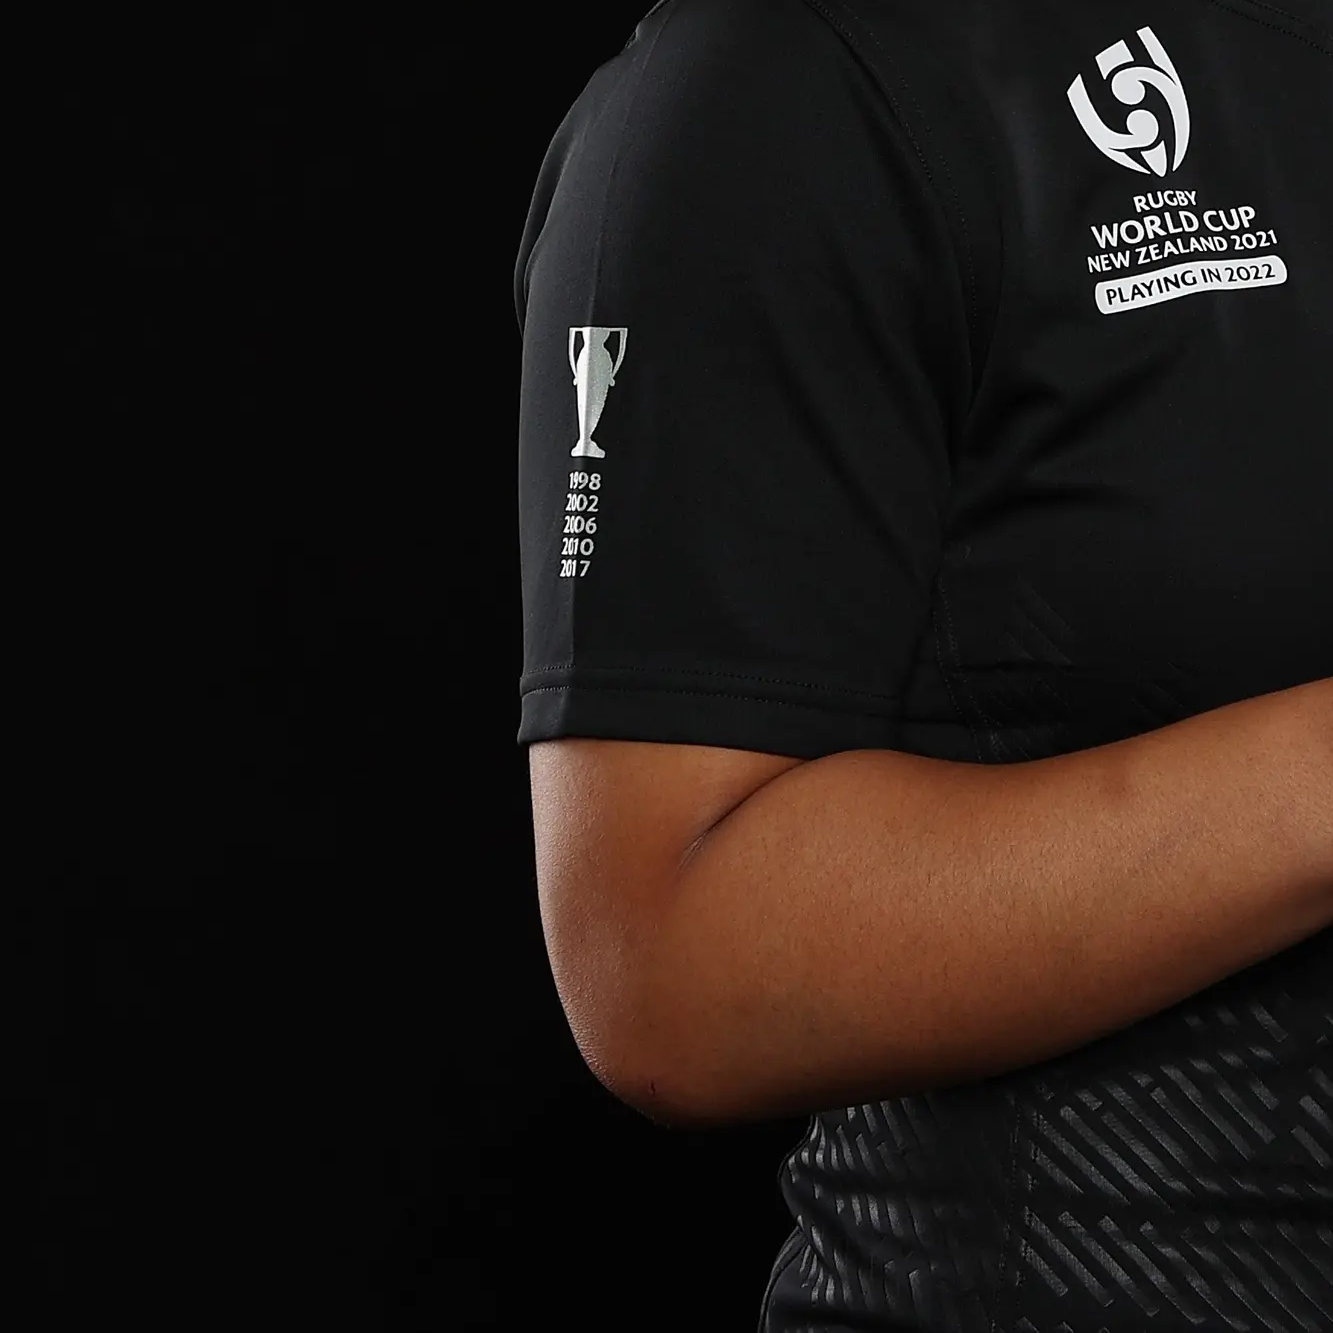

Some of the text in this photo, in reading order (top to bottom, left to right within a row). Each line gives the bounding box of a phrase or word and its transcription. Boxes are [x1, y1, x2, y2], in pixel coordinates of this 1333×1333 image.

[1133, 190, 1197, 213] RUGBY
[1091, 206, 1256, 249] WORLD CUP
[1087, 230, 1278, 274] NEW ZEALAND 2021
[1105, 264, 1276, 306] PLAYING IN 2022
[569, 471, 601, 491] 1998
[565, 493, 599, 513] 2002
[562, 515, 597, 535] 2006
[561, 537, 594, 556] 2010
[559, 559, 591, 578] 2017
